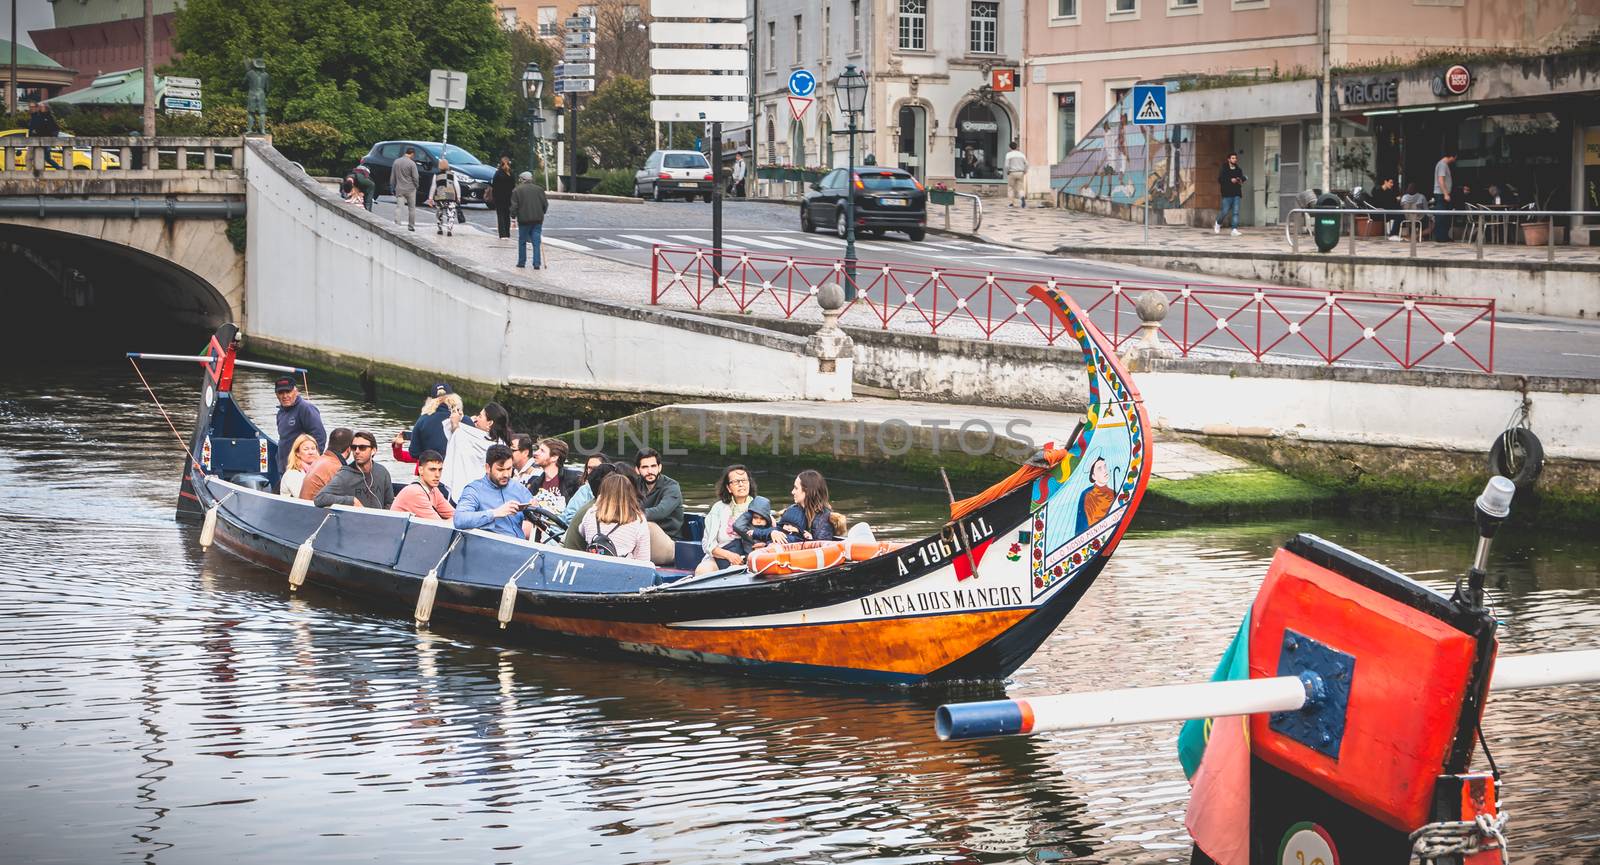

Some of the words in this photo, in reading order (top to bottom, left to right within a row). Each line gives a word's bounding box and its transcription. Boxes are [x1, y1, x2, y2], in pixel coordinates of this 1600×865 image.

[970, 517, 994, 542] AL
[552, 559, 585, 585] MT
[917, 591, 951, 611] DOS
[954, 586, 1023, 609] MANCOS
